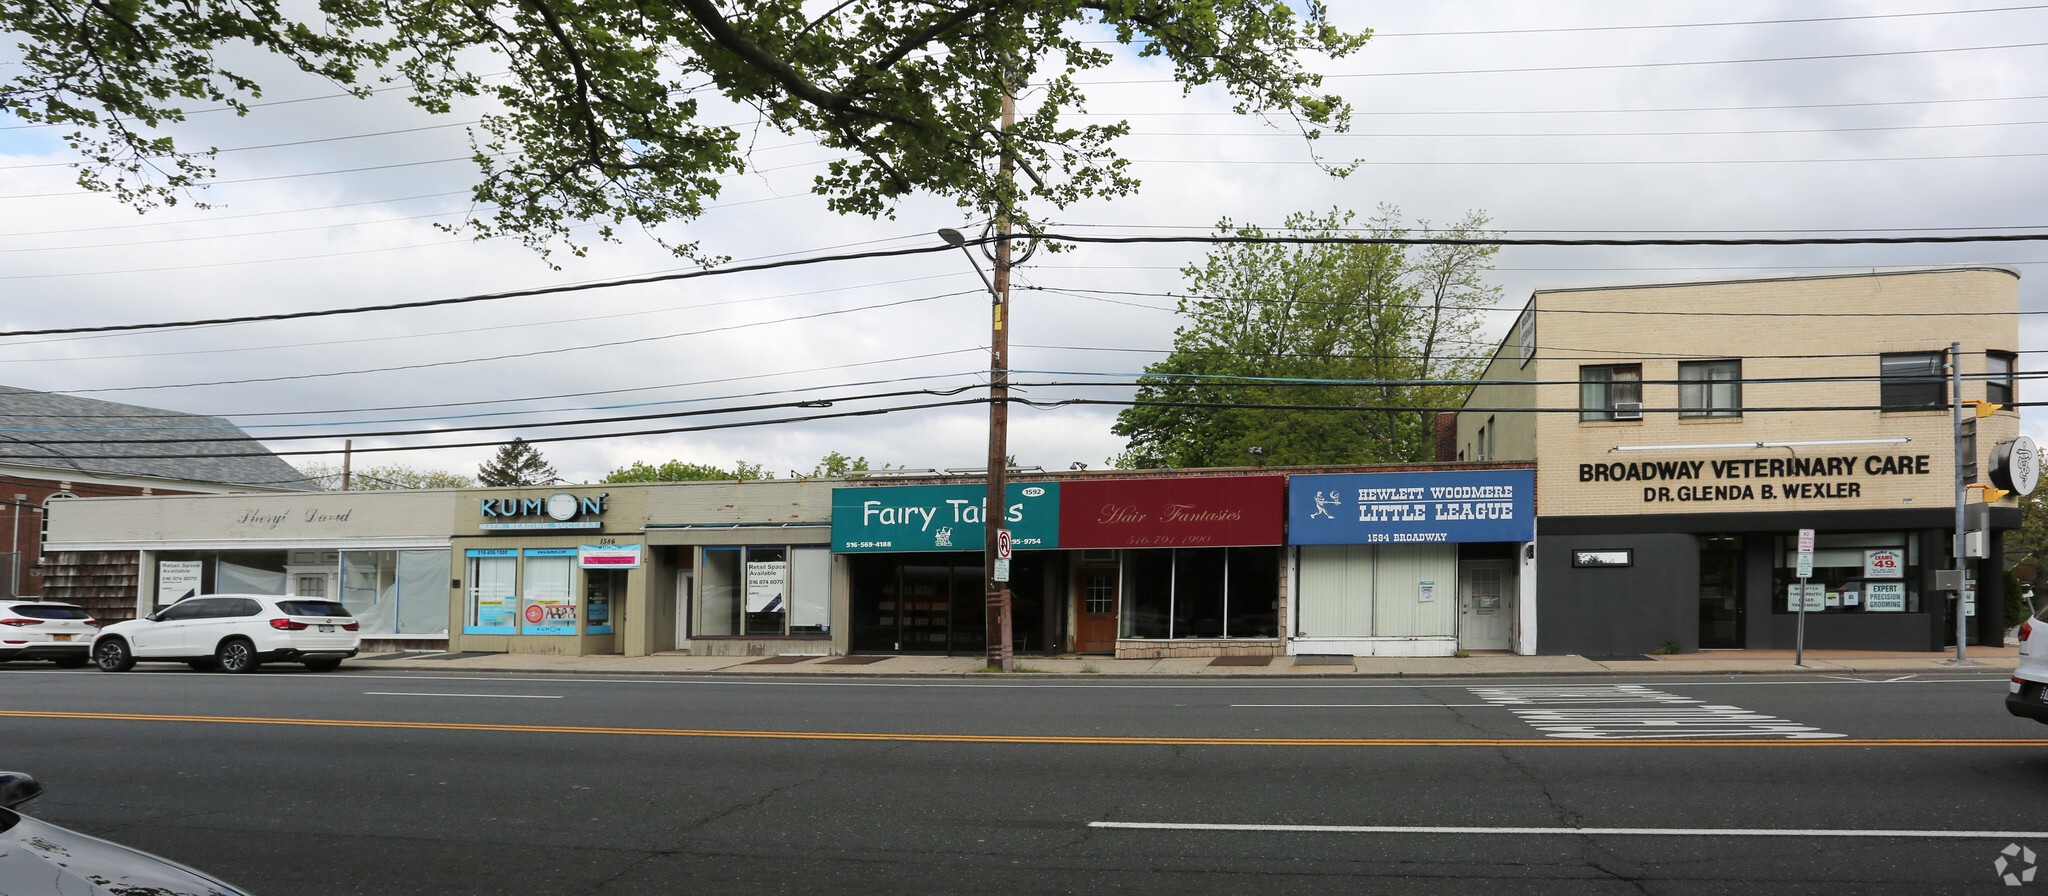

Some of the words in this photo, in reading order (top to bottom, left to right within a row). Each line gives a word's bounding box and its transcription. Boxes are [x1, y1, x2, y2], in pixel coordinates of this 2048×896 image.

[1580, 460, 1704, 482] BROADWAY
[1711, 456, 1858, 479] VETERINARY
[1864, 455, 1930, 475] CARE
[1358, 488, 1424, 500] HEWLETT
[1430, 486, 1512, 499] WOODMERE
[1644, 487, 1674, 502] DR.
[1678, 484, 1754, 502] GLENDA
[1762, 484, 1778, 499] B.
[1782, 482, 1860, 499] WEXLER
[480, 493, 600, 520] KUMON
[864, 501, 936, 531] Fairy
[946, 498, 1023, 523] Tals
[1098, 504, 1147, 523] Hair
[1160, 504, 1241, 522] Fantasies
[1359, 505, 1426, 522] LITTLE
[1435, 503, 1512, 520] LEAGUE
[1368, 534, 1389, 542] 1594
[1394, 533, 1447, 542] BROADWAY
